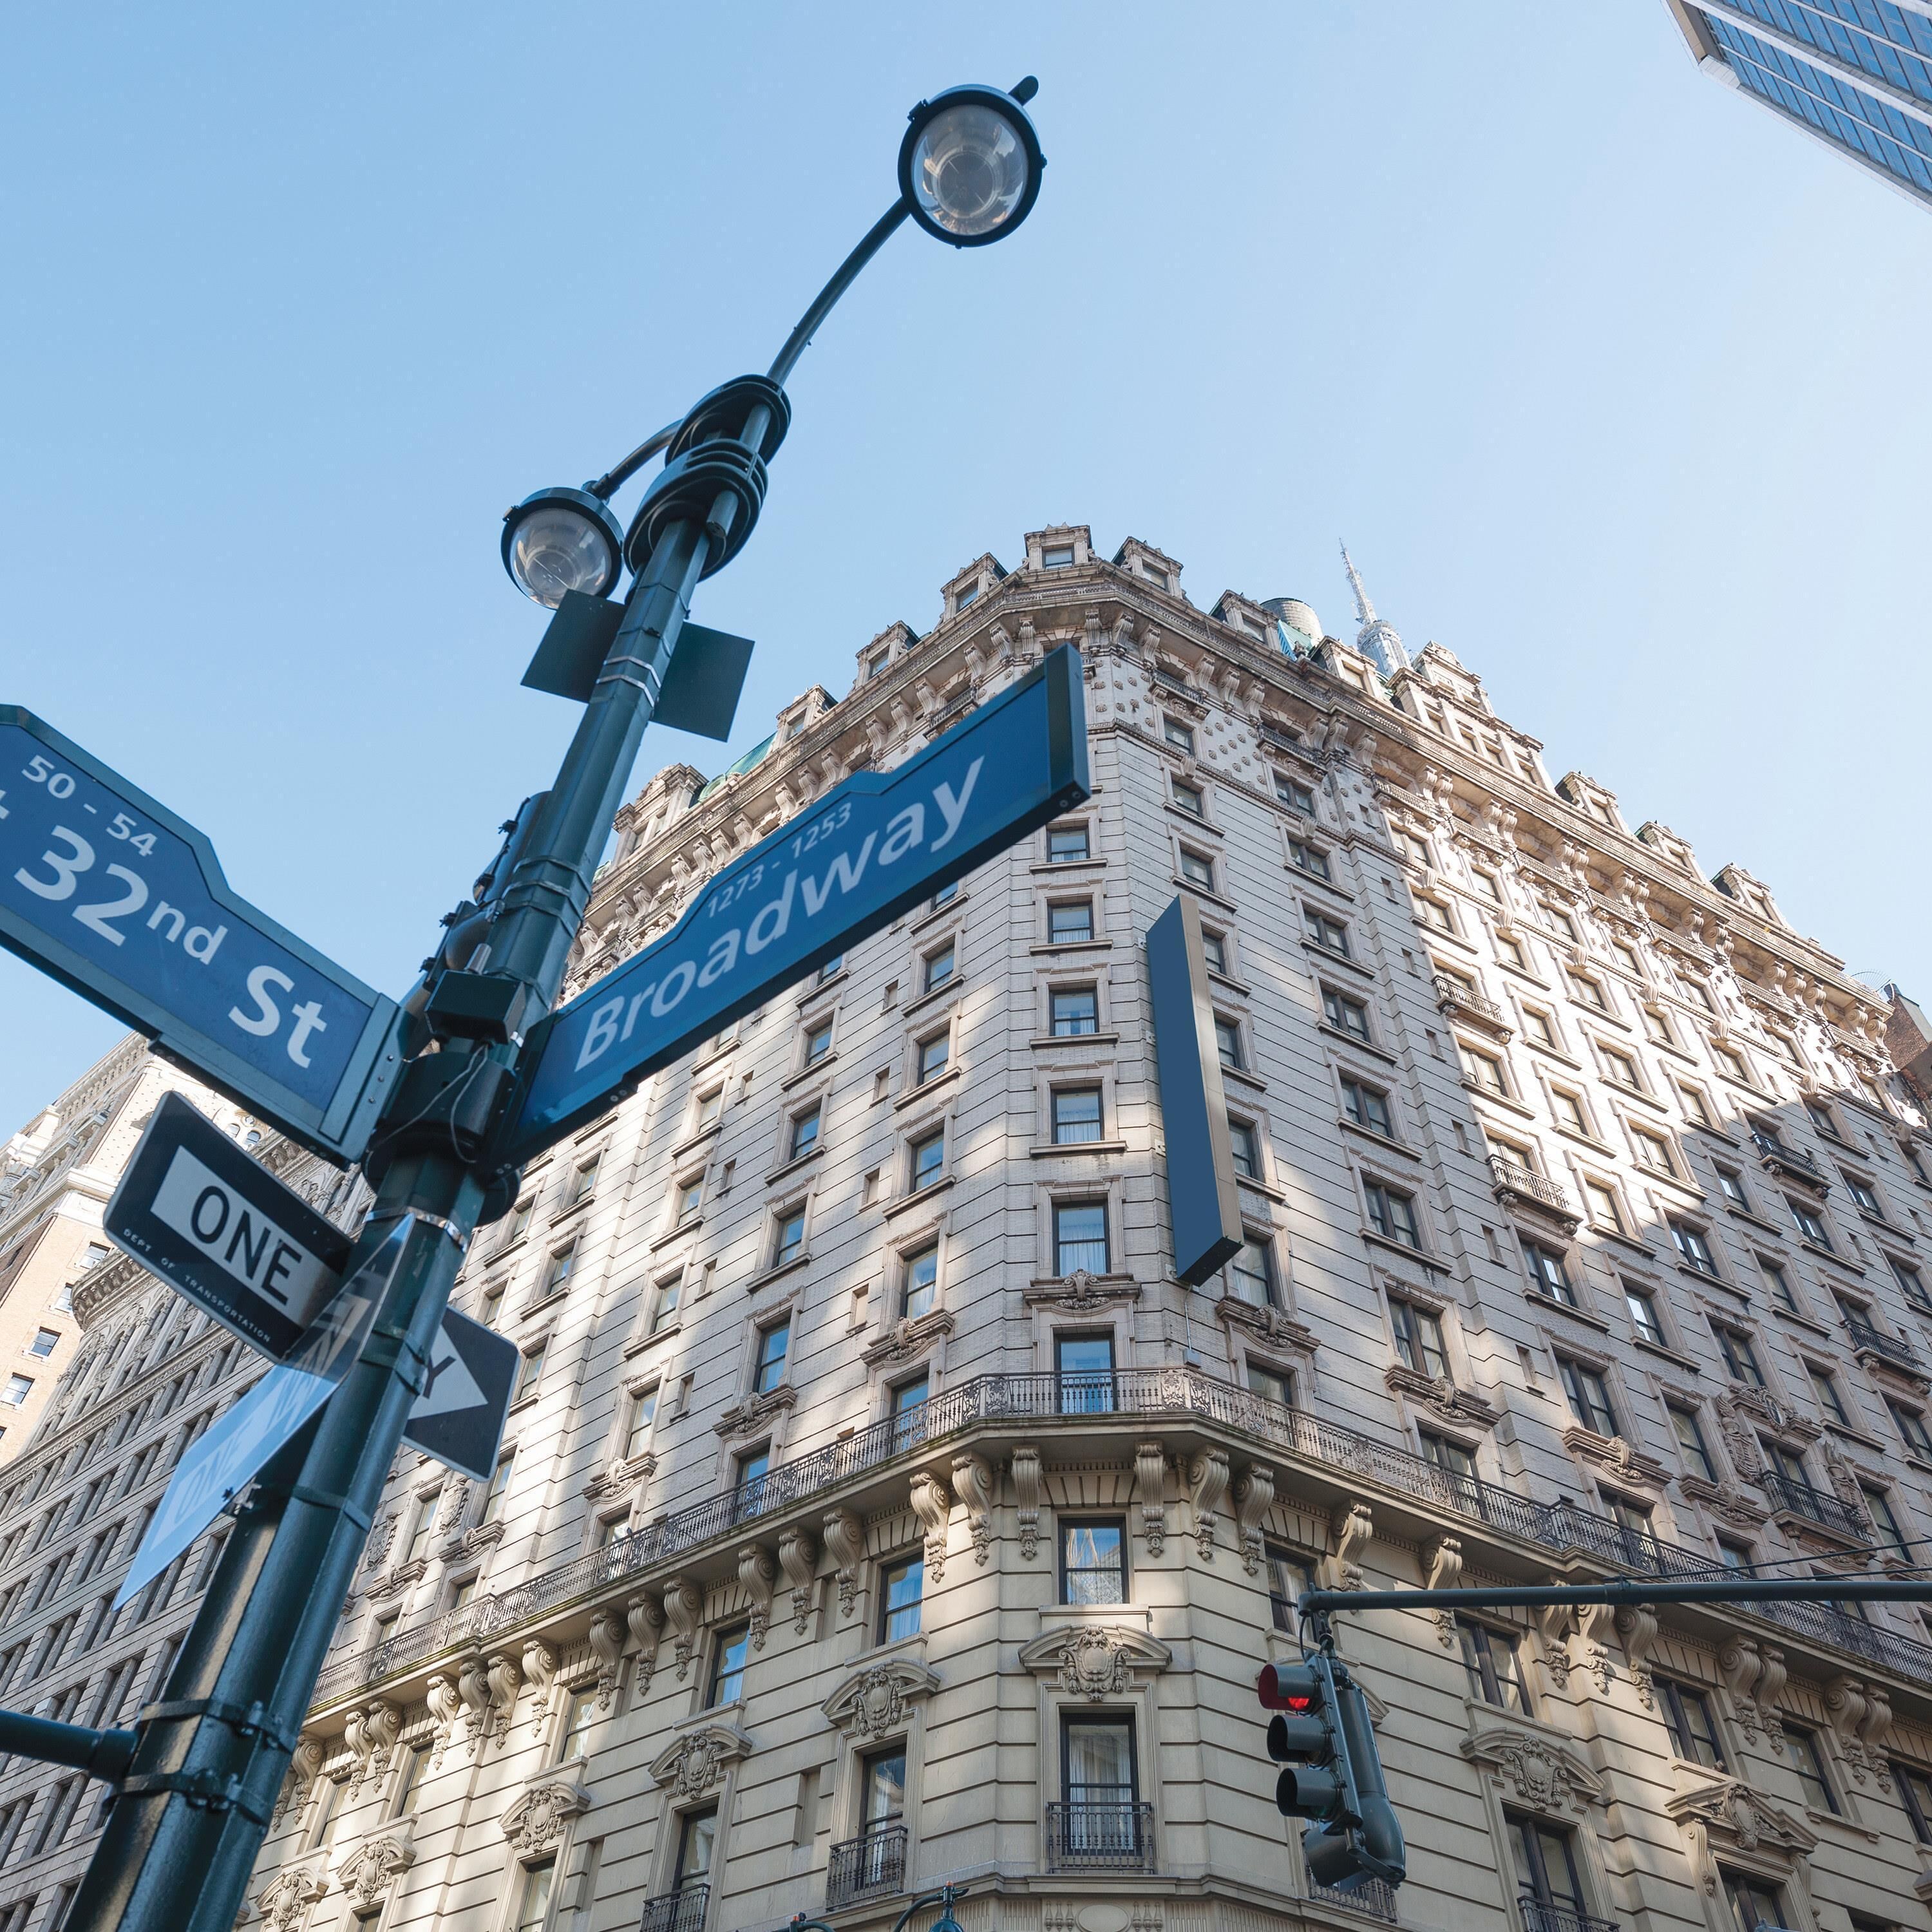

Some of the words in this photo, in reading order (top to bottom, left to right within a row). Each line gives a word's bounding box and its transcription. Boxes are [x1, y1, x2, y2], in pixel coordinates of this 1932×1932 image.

[21, 755, 75, 799] 50
[106, 812, 157, 857] 54
[708, 864, 764, 918] 1273
[792, 802, 851, 858] 1253
[14, 825, 228, 965] 32nd
[228, 965, 327, 1068] St
[574, 755, 984, 1072] Broadway
[123, 1228, 152, 1252] DEPT
[161, 1257, 176, 1269] OF
[184, 1274, 271, 1343] TRANSPORTATION
[191, 1185, 302, 1306] ONE
